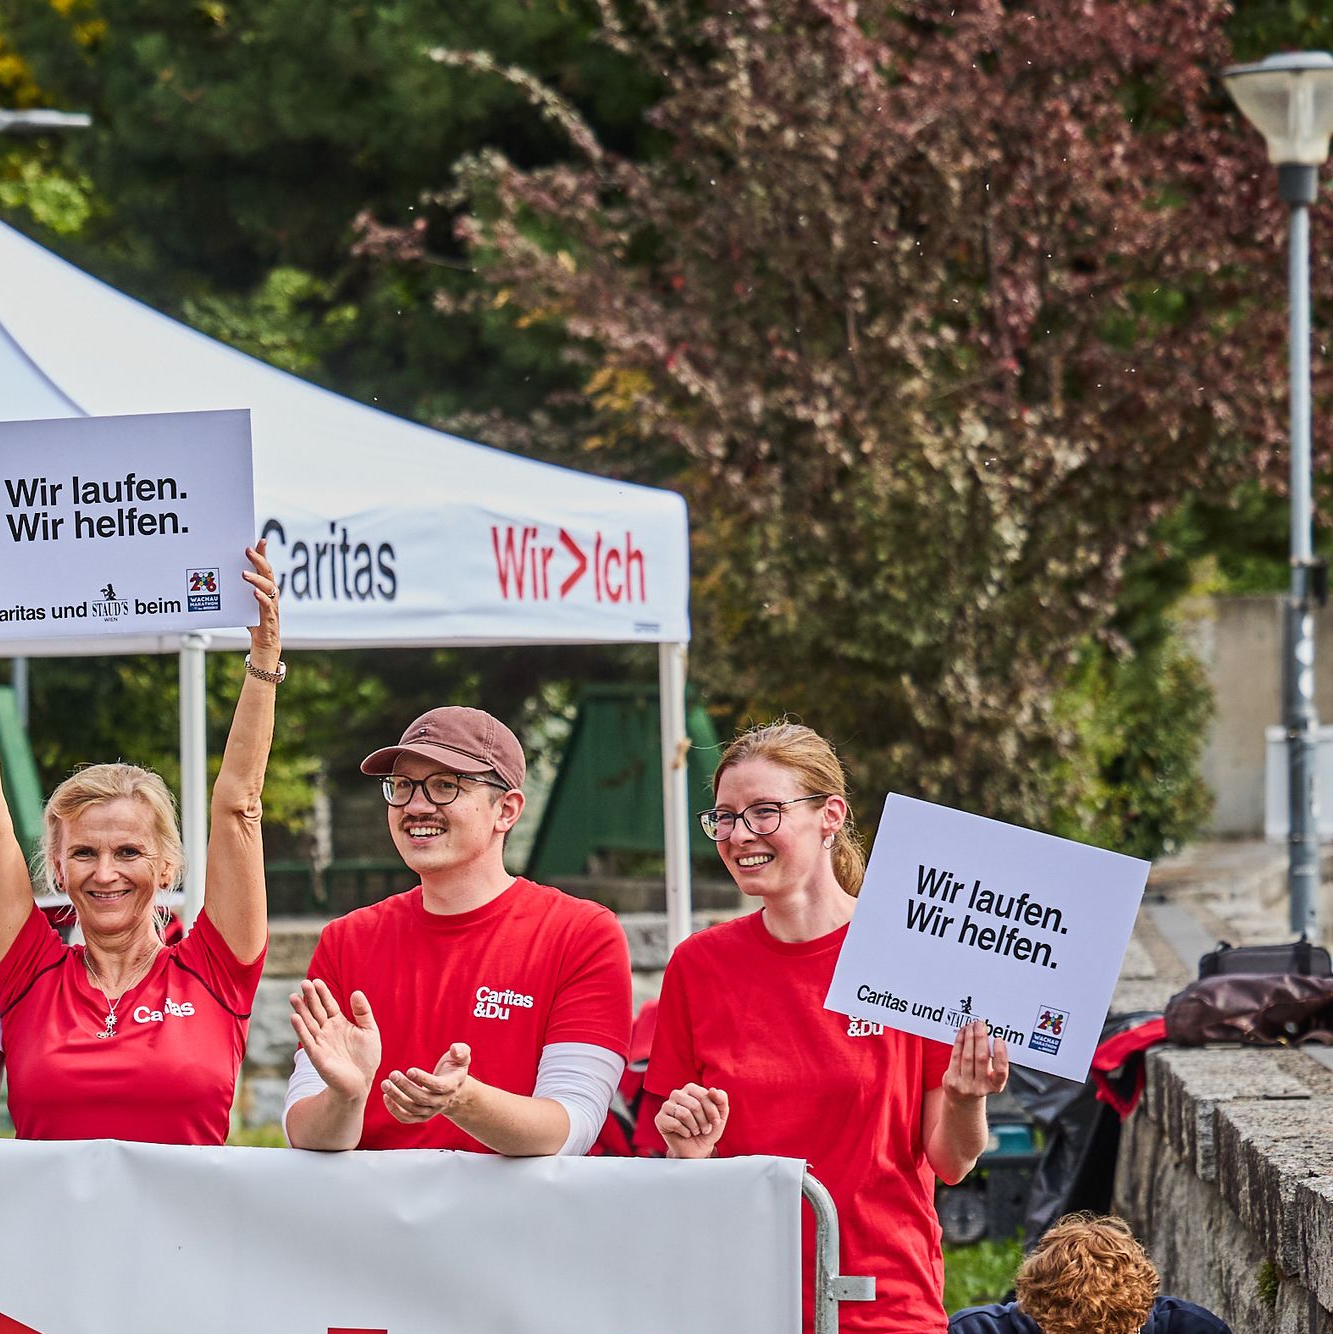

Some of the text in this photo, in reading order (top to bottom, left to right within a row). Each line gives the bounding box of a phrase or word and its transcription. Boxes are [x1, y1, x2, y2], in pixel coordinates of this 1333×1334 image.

[4, 473, 187, 508] Wir laufen.
[6, 508, 189, 542] Wir helfen.
[51, 602, 87, 619] und
[91, 600, 129, 618] STAUD'S
[134, 597, 181, 615] beim
[917, 865, 1068, 935] Wir laufen.
[906, 899, 1058, 970] Wir helfen.
[473, 1001, 510, 1020] &Du
[476, 986, 534, 1008] Caritas
[847, 1020, 884, 1037] &Du
[857, 984, 908, 1013] Caritas
[911, 1002, 945, 1023] und
[985, 1018, 1025, 1046] beim
